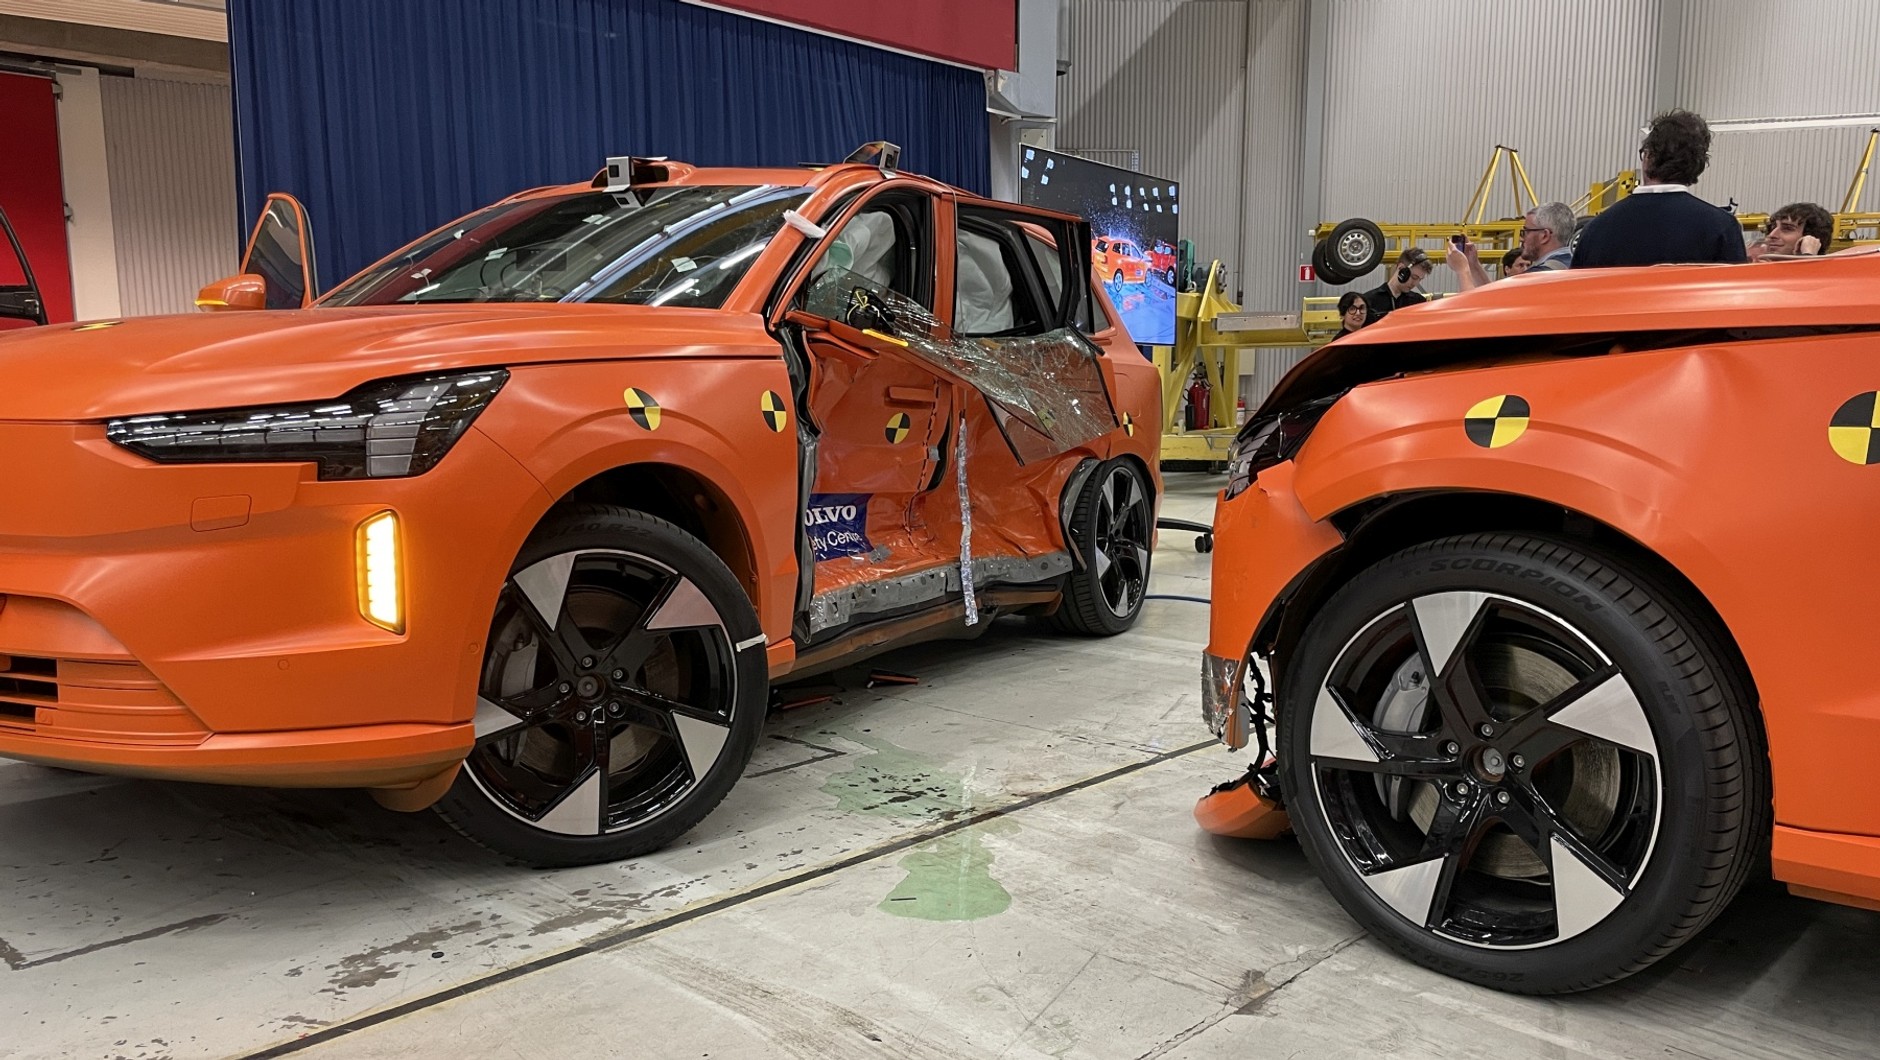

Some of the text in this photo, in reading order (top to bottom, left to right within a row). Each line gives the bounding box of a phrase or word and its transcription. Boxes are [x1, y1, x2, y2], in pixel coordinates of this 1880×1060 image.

[804, 505, 857, 526] OLVO
[811, 536, 827, 551] ety
[1429, 558, 1603, 612] SCORPION
